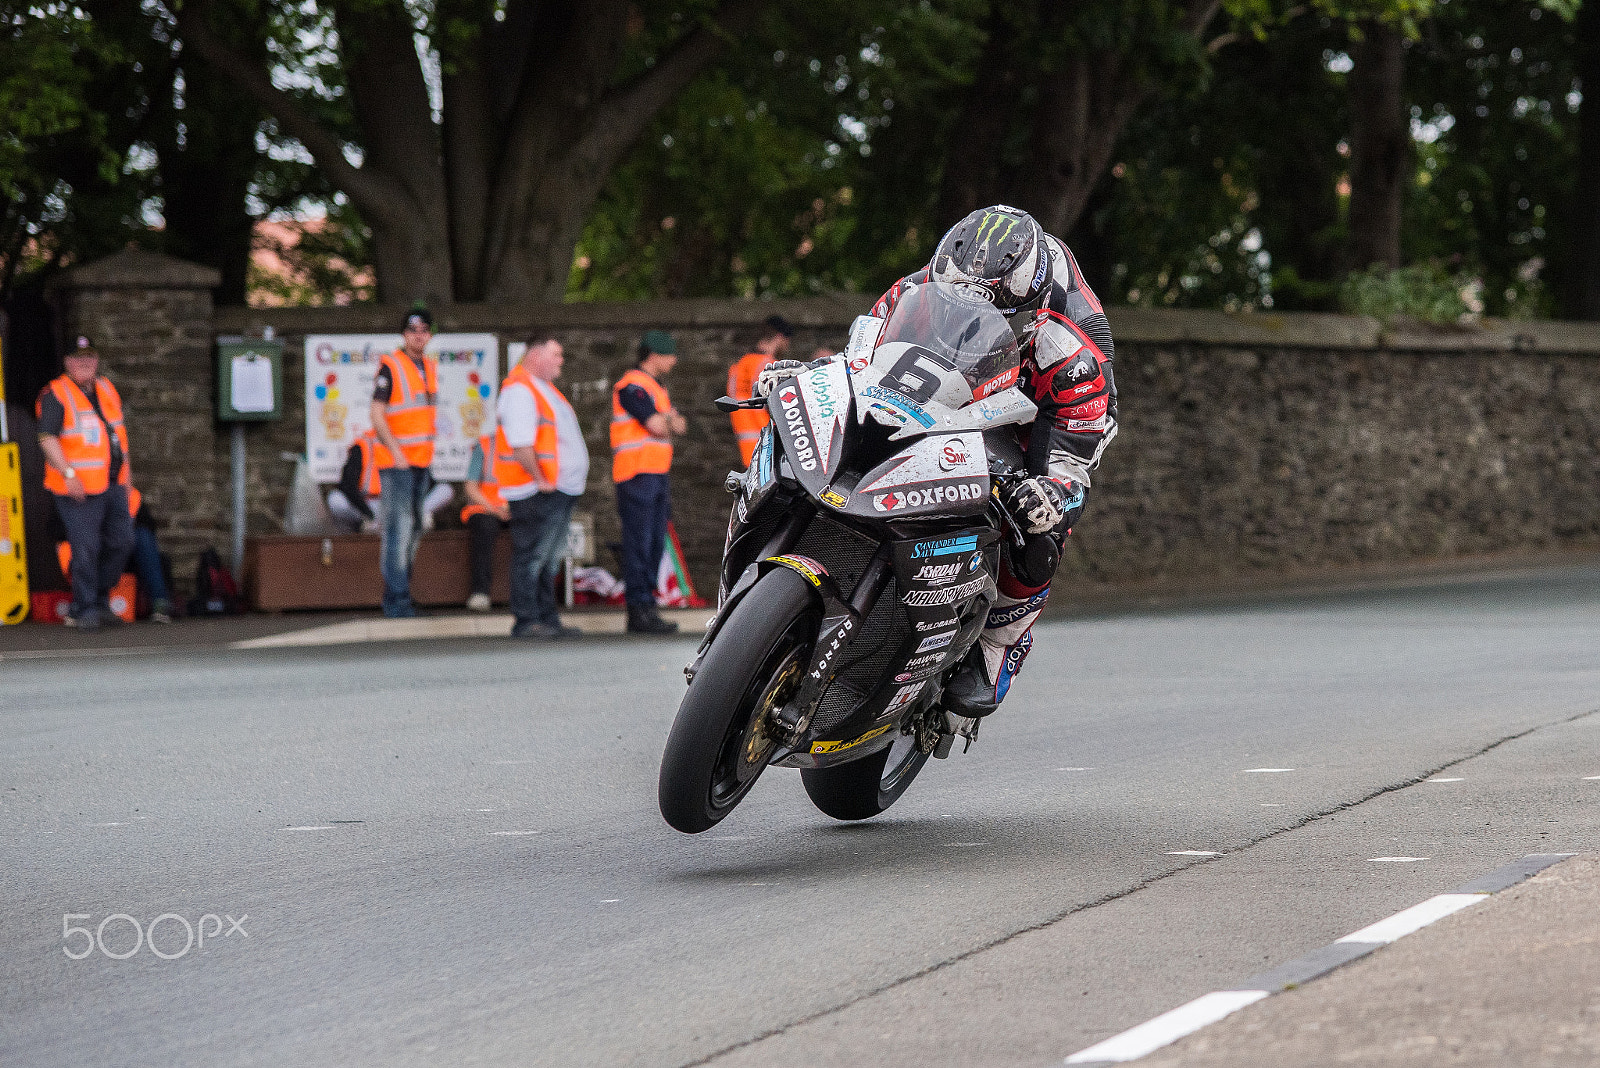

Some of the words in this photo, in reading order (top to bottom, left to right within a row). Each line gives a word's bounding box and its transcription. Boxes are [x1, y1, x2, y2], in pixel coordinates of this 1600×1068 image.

[878, 345, 958, 406] 6
[982, 370, 1013, 396] MOTUL
[810, 368, 837, 419] Kubota
[784, 407, 818, 472] OXFORD
[906, 483, 982, 507] OXFORD
[912, 562, 964, 579] JORDAN
[990, 595, 1044, 624] daytona
